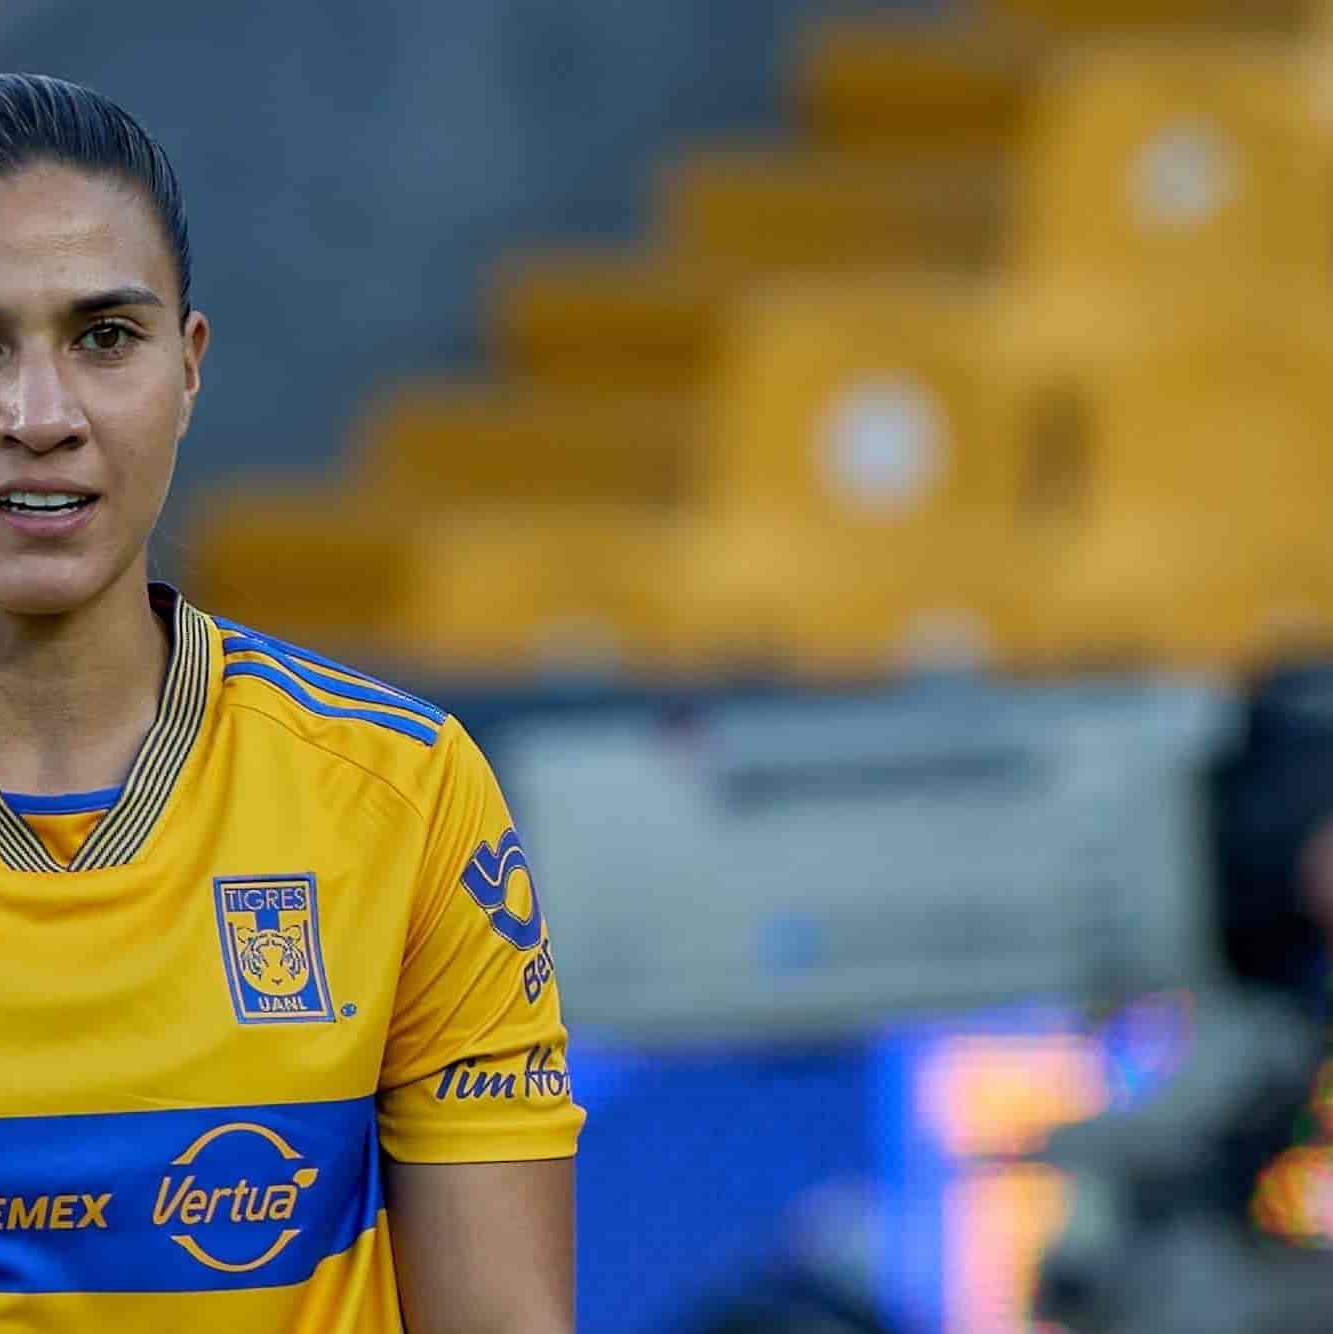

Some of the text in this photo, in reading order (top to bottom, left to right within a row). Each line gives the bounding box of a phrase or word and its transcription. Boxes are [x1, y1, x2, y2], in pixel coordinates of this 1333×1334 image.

[225, 886, 307, 911] TIGRES
[257, 995, 308, 1013] UANL
[435, 1056, 517, 1100] Tim
[151, 1174, 301, 1226] Vertua
